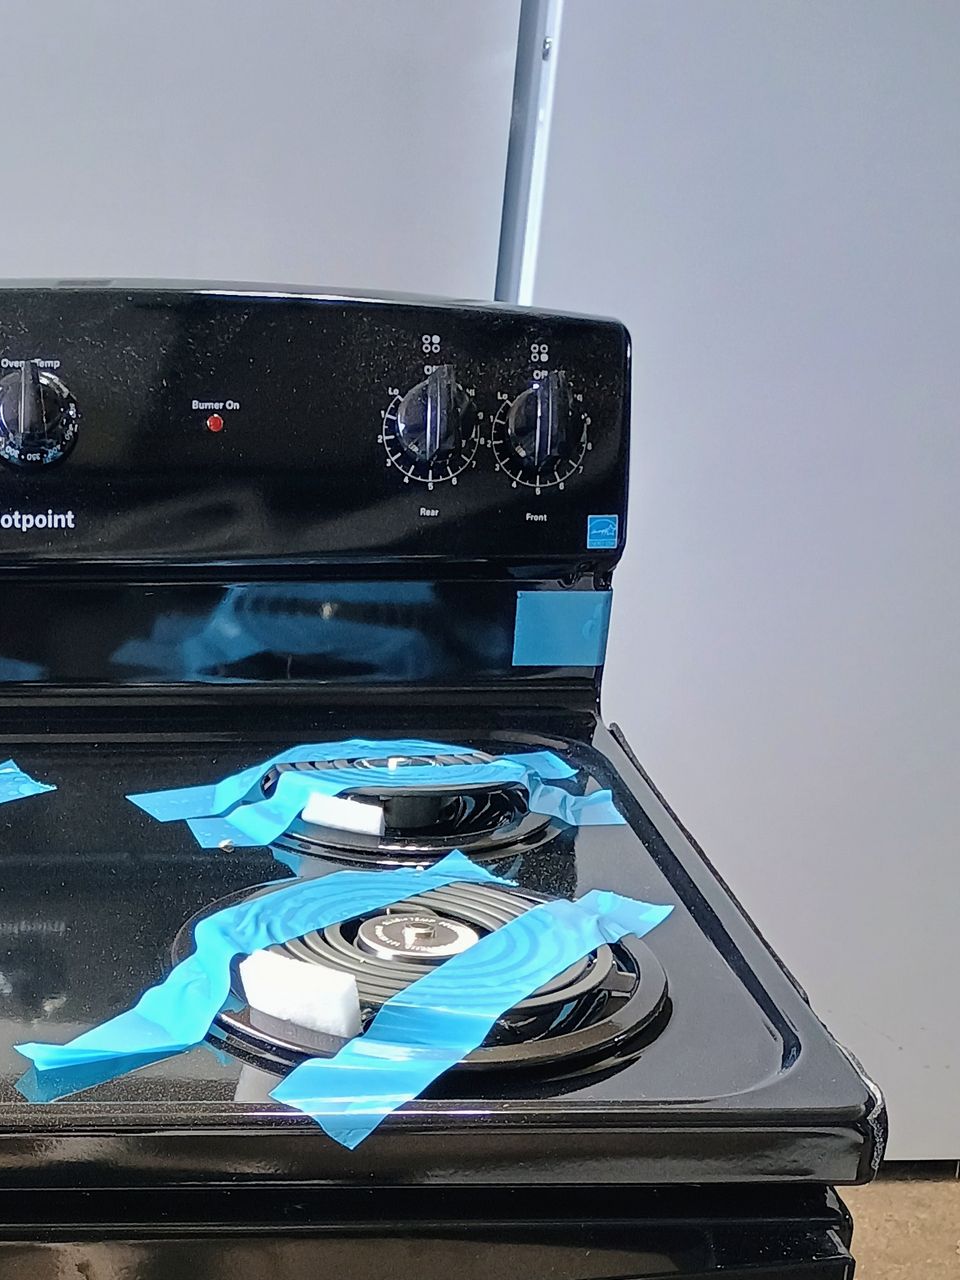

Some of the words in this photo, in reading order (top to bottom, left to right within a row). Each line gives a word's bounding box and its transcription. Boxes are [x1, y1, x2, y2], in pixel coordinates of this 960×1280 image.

[0, 358, 25, 368] Oven
[31, 358, 61, 369] Temp
[388, 387, 400, 396] Lo
[497, 391, 508, 400] Lo
[192, 400, 224, 410] Burner
[225, 400, 240, 410] On
[420, 507, 439, 516] Rear
[526, 512, 547, 522] Front
